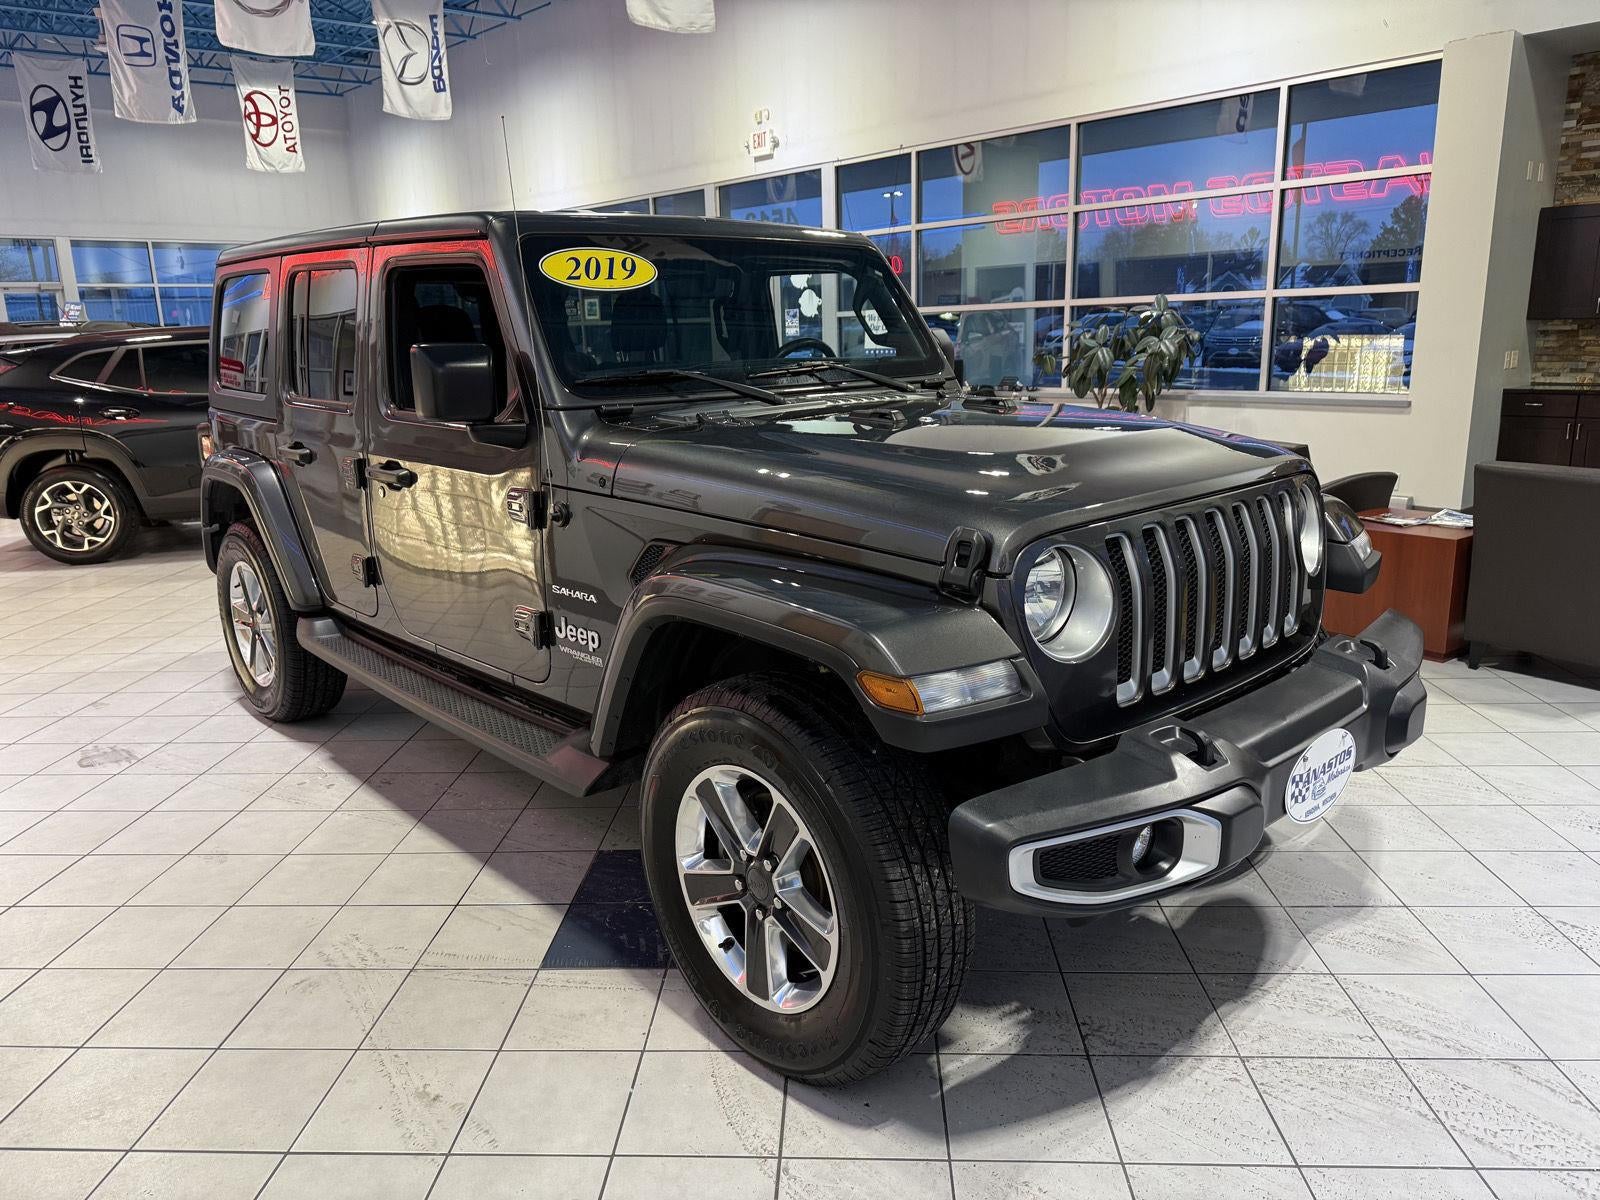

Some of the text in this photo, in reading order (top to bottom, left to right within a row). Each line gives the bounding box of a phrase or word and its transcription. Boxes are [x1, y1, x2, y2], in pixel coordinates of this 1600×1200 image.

[752, 131, 767, 149] EXIT
[565, 256, 637, 280] 2019
[552, 584, 598, 603] SAHARA
[555, 616, 600, 652] Jeep
